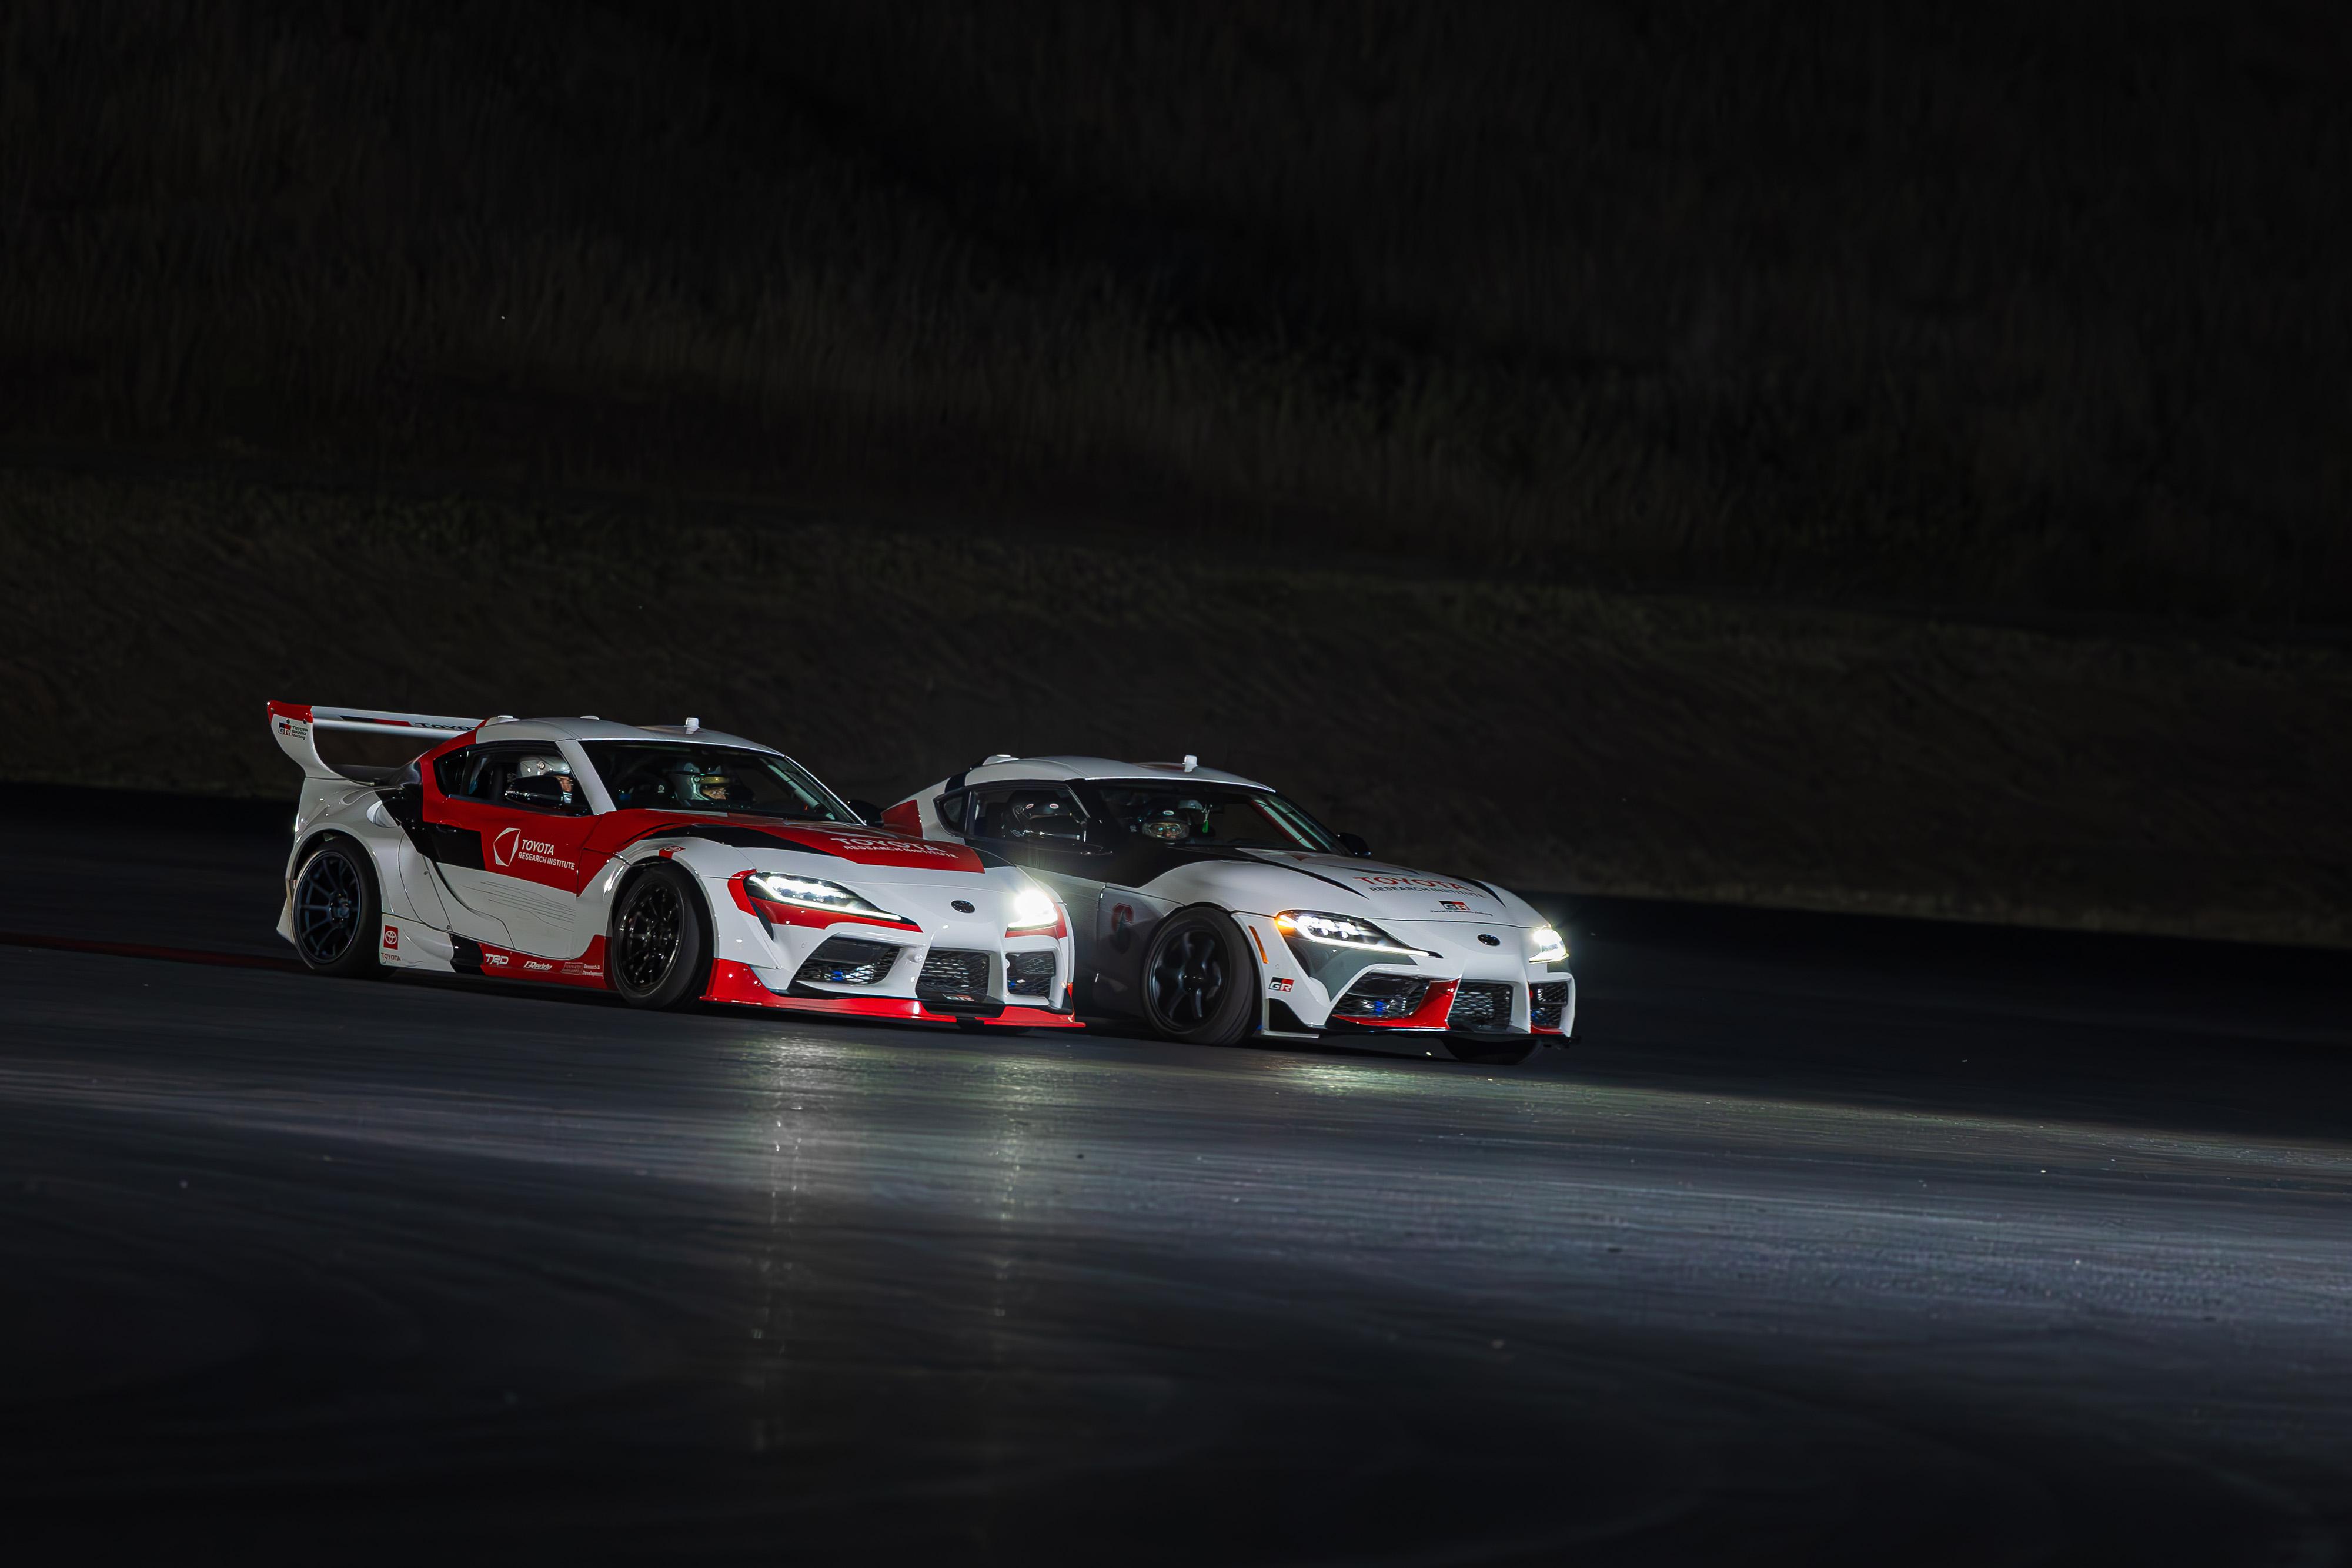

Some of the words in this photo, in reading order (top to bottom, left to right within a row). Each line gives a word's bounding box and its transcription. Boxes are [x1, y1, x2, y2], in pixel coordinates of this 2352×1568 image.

[522, 839, 554, 855] TOYOTA
[830, 838, 947, 853] TOYOTA
[518, 851, 547, 864] RESEARCH
[547, 857, 576, 870] INSTITUTE
[1352, 877, 1474, 892] TOYOTA
[381, 952, 401, 962] TOYOTA
[485, 953, 509, 965] TRD
[1269, 982, 1292, 992] GR
